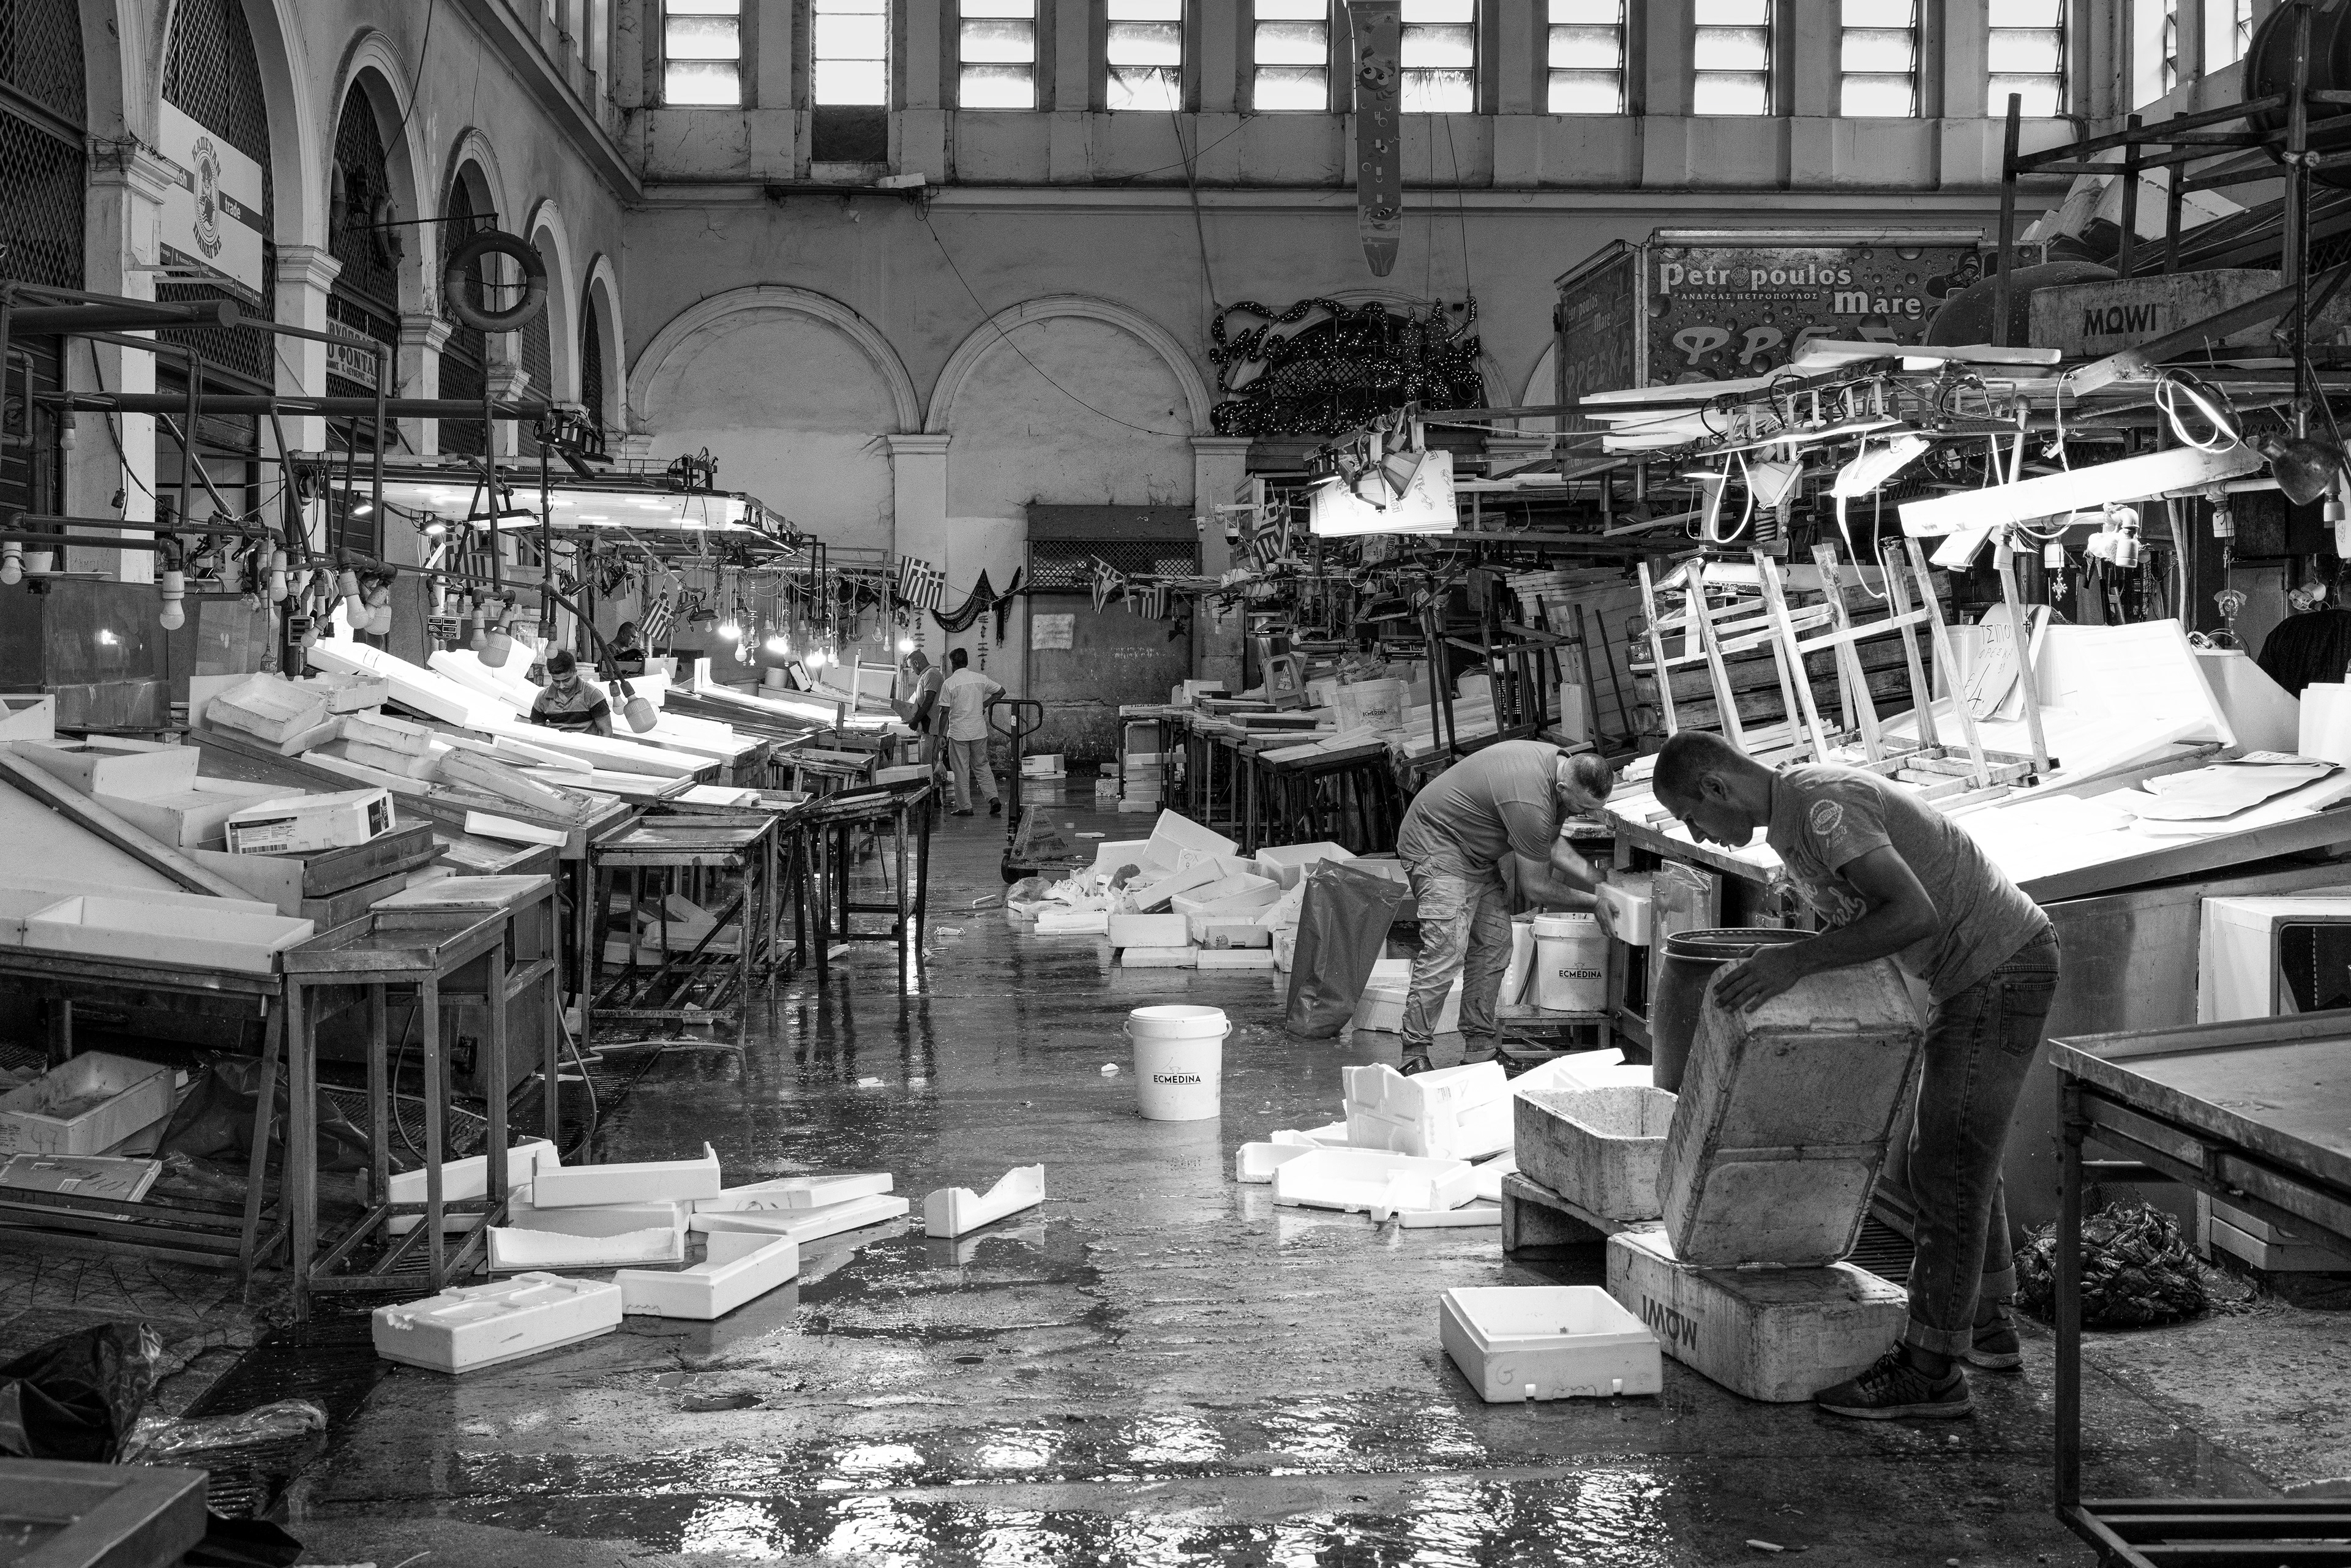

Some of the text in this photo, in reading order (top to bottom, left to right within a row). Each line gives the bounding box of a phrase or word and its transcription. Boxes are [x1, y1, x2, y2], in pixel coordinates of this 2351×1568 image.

[192, 137, 221, 178] ΚΑΠΕΤΑΝ
[176, 170, 241, 219] ish trade
[193, 221, 222, 259] ΠΑΝΑΓΗΣ
[1979, 624, 2011, 645] ΤΣΙΠΟ
[1813, 805, 1842, 828] ALIFORNIA
[1153, 1075, 1201, 1083] ECMEDINA
